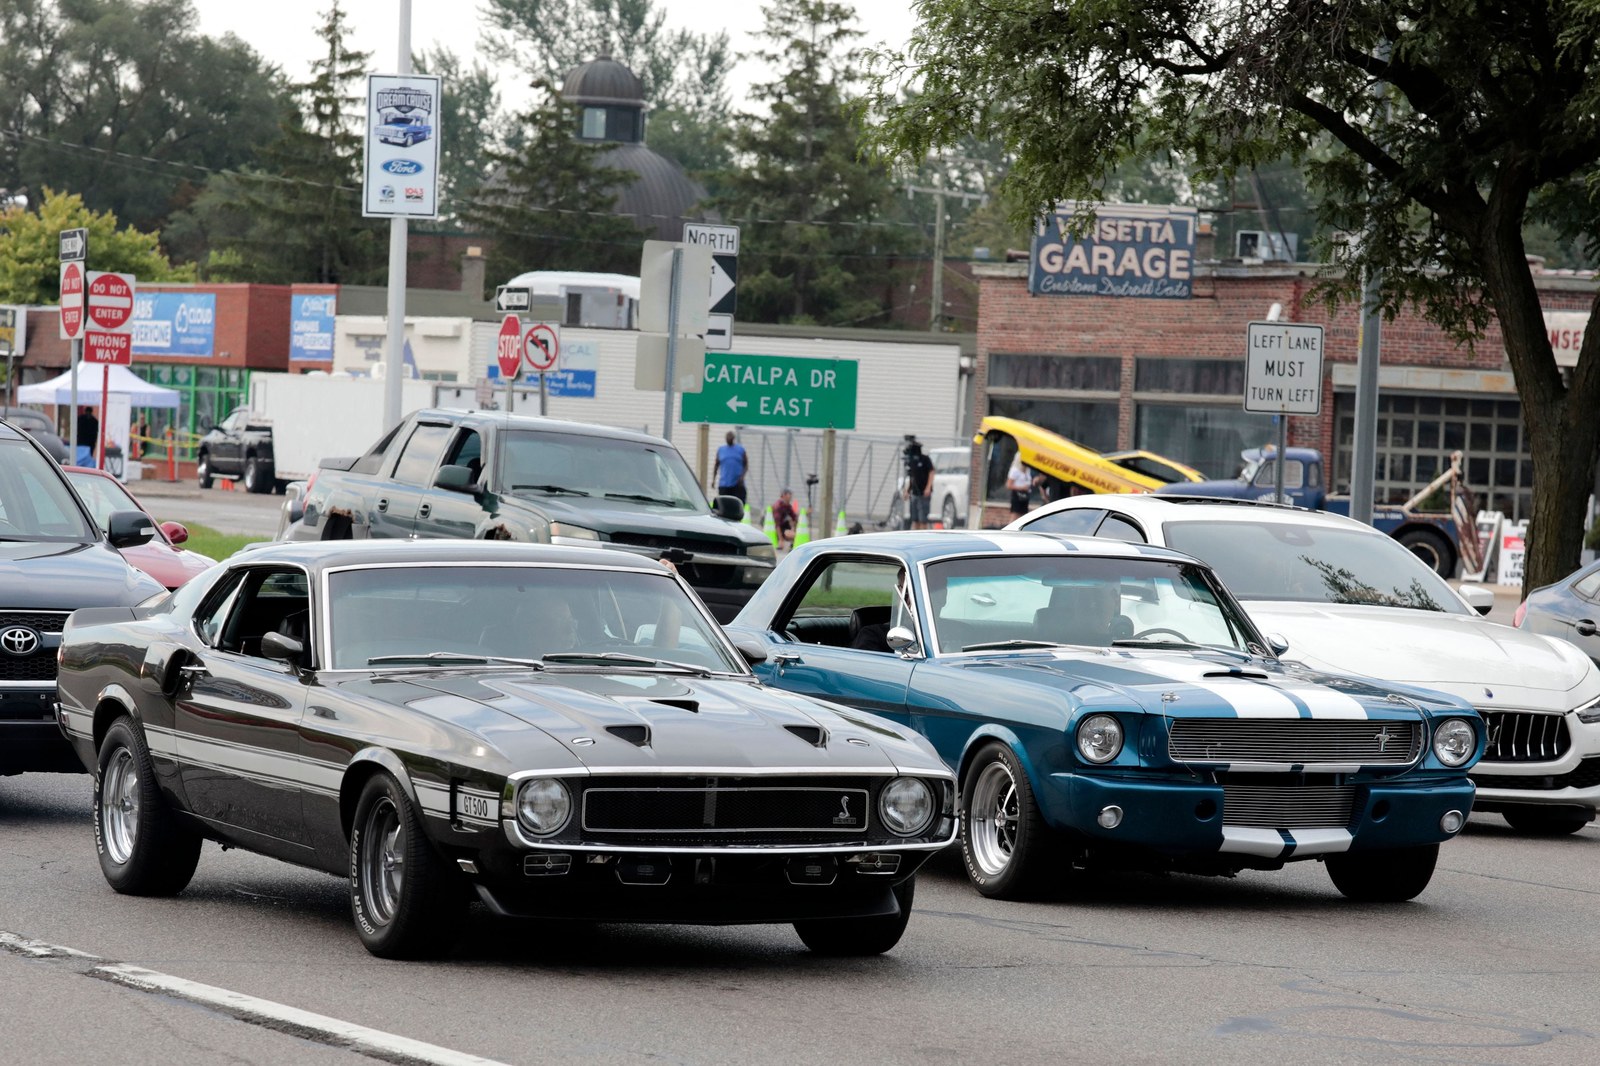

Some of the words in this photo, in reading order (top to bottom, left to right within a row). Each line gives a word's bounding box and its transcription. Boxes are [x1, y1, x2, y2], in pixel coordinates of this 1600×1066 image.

[378, 93, 405, 110] DREAM
[406, 94, 432, 112] CRUISE
[388, 160, 417, 175] Ford
[688, 229, 735, 250] NORTH
[1056, 217, 1176, 244] VNSETTA
[1039, 243, 1191, 280] GARAGE
[64, 279, 70, 291] DO
[71, 277, 80, 290] NOT
[93, 283, 105, 294] DO
[110, 285, 127, 295] NOT
[1040, 275, 1098, 293] Custom
[1098, 277, 1154, 296] Detroit
[1156, 279, 1189, 297] Eats
[65, 310, 79, 323] ENTER
[95, 308, 123, 319] ENTER
[188, 308, 213, 325] CLOUD
[89, 334, 127, 349] WRONG
[498, 334, 520, 360] STOP
[1253, 334, 1283, 349] LEFT
[1288, 336, 1317, 351] LANE
[95, 348, 119, 361] WAY
[704, 363, 799, 387] CATALPA
[810, 369, 837, 389] DR
[1264, 359, 1305, 378] MUST
[1251, 386, 1283, 401] TURN
[1288, 388, 1315, 403] LEFT
[759, 396, 814, 417] EAST
[1033, 452, 1077, 478] MOTOWN
[463, 795, 472, 814] GT
[473, 797, 488, 817] 500
[351, 829, 360, 889] COBRA
[353, 894, 376, 936] COOPER
